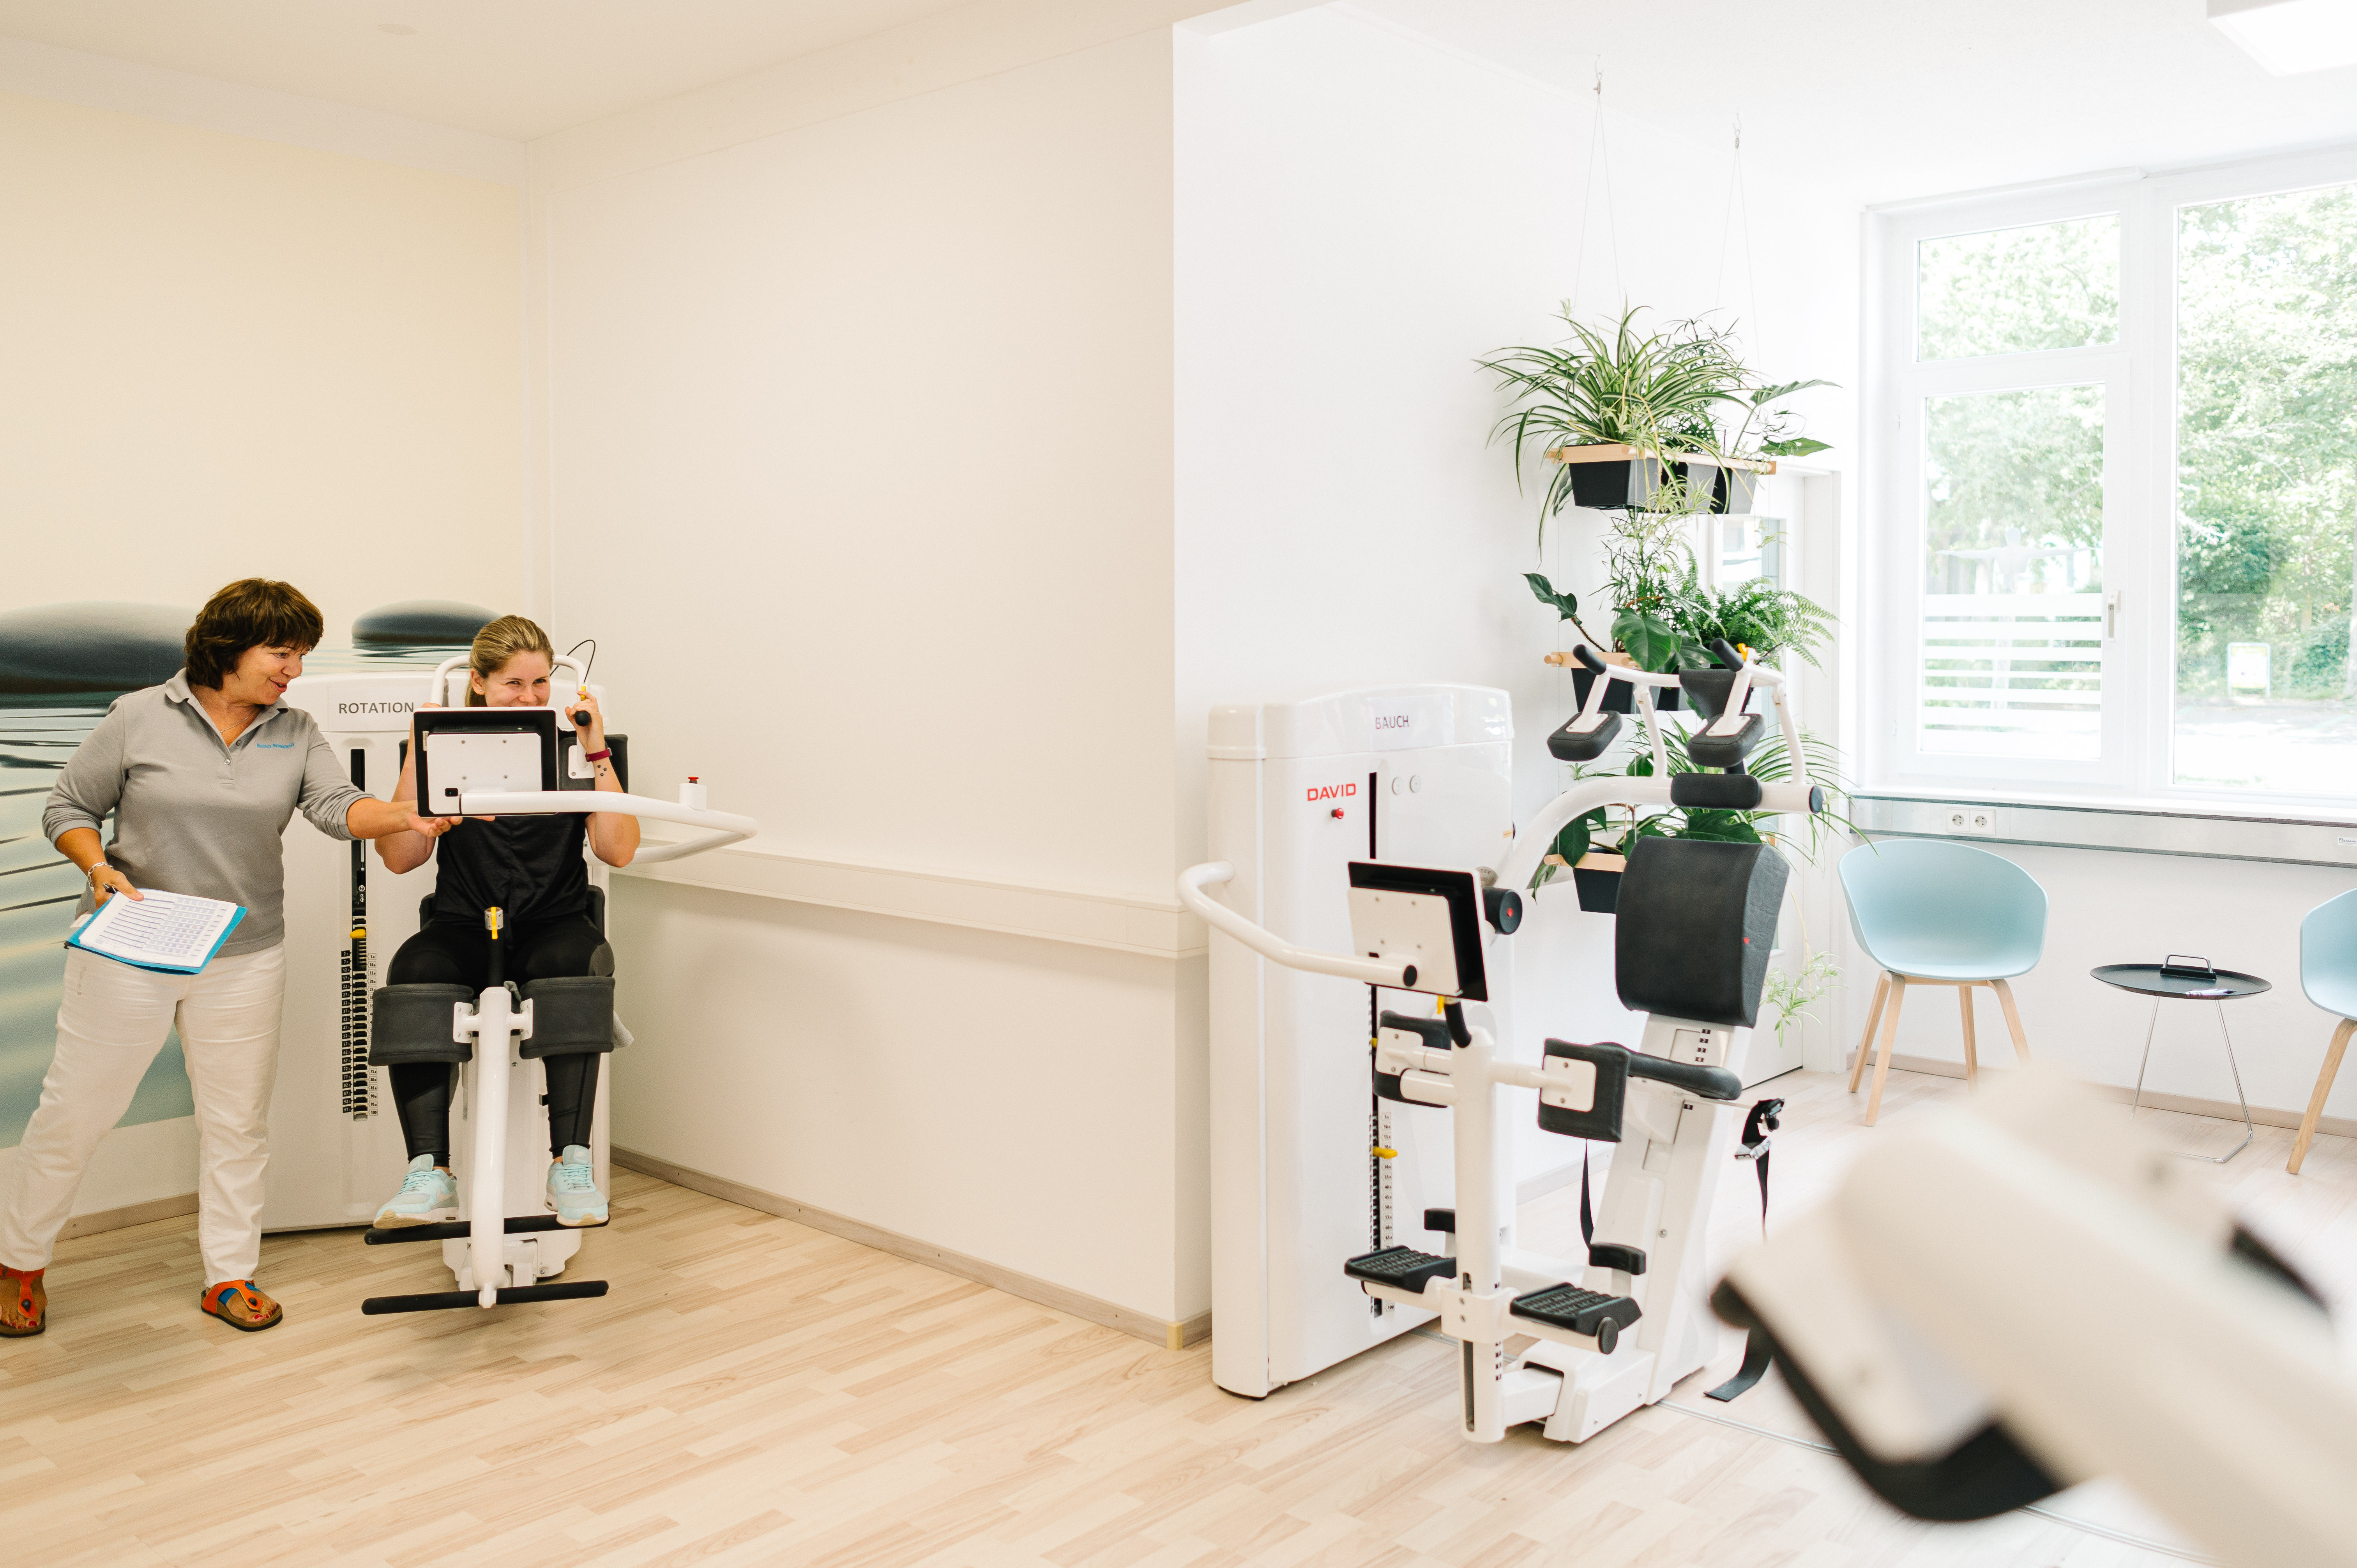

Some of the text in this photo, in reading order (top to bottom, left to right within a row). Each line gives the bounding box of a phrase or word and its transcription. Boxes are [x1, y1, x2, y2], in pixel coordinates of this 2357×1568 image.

[339, 702, 414, 714] ROTATION
[1375, 715, 1409, 729] BAUCH
[1307, 783, 1356, 801] DAVID
